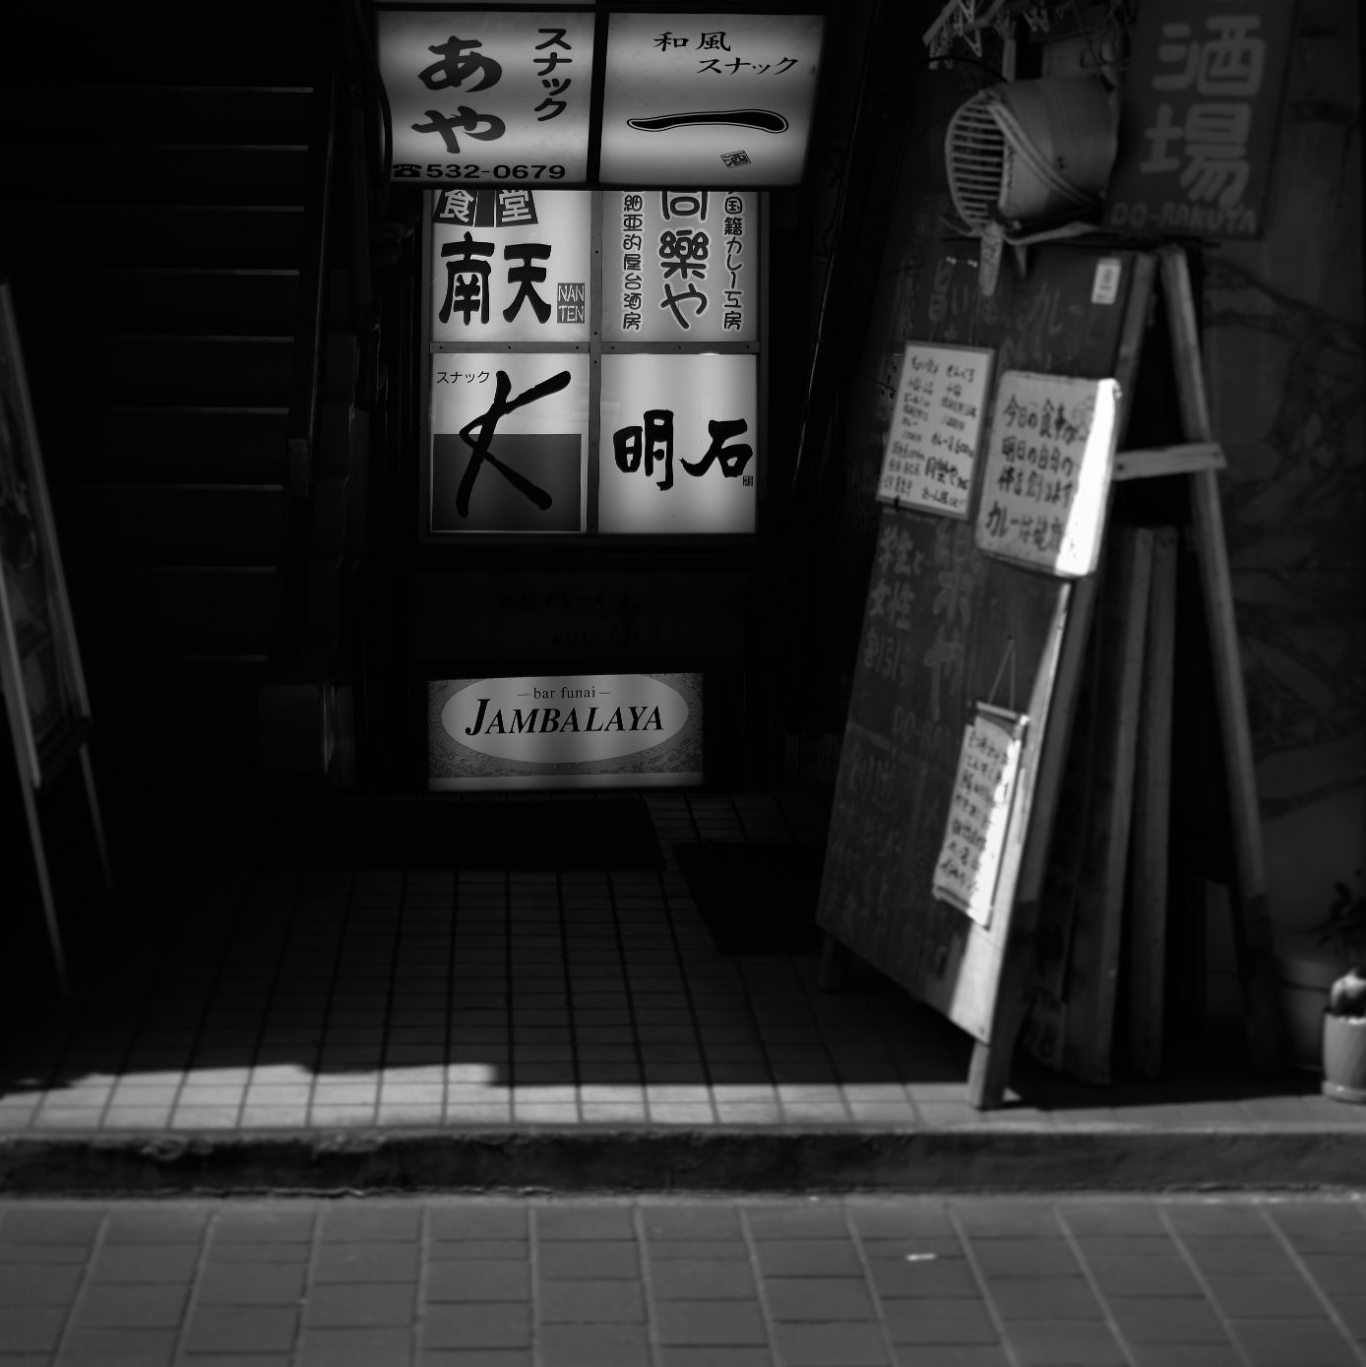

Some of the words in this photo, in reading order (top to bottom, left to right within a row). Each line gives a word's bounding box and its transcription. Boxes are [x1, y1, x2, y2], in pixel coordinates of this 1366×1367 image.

[653, 30, 732, 52] 和風
[534, 27, 573, 123] スナック
[696, 56, 799, 76] スナック
[411, 35, 507, 154] あや
[426, 163, 567, 181] 532-0679
[438, 189, 532, 224] 食堂
[622, 190, 643, 331] 細亜的屋台酒房
[722, 190, 744, 331] 国籍カレー工房
[438, 231, 553, 326] 南天
[557, 284, 585, 303] NAN
[557, 305, 585, 323] TEN
[436, 370, 490, 385] スナック
[613, 409, 753, 492] 明石
[532, 686, 556, 700] bar
[561, 685, 597, 699] funai
[465, 698, 665, 736] JAMBALAYA
